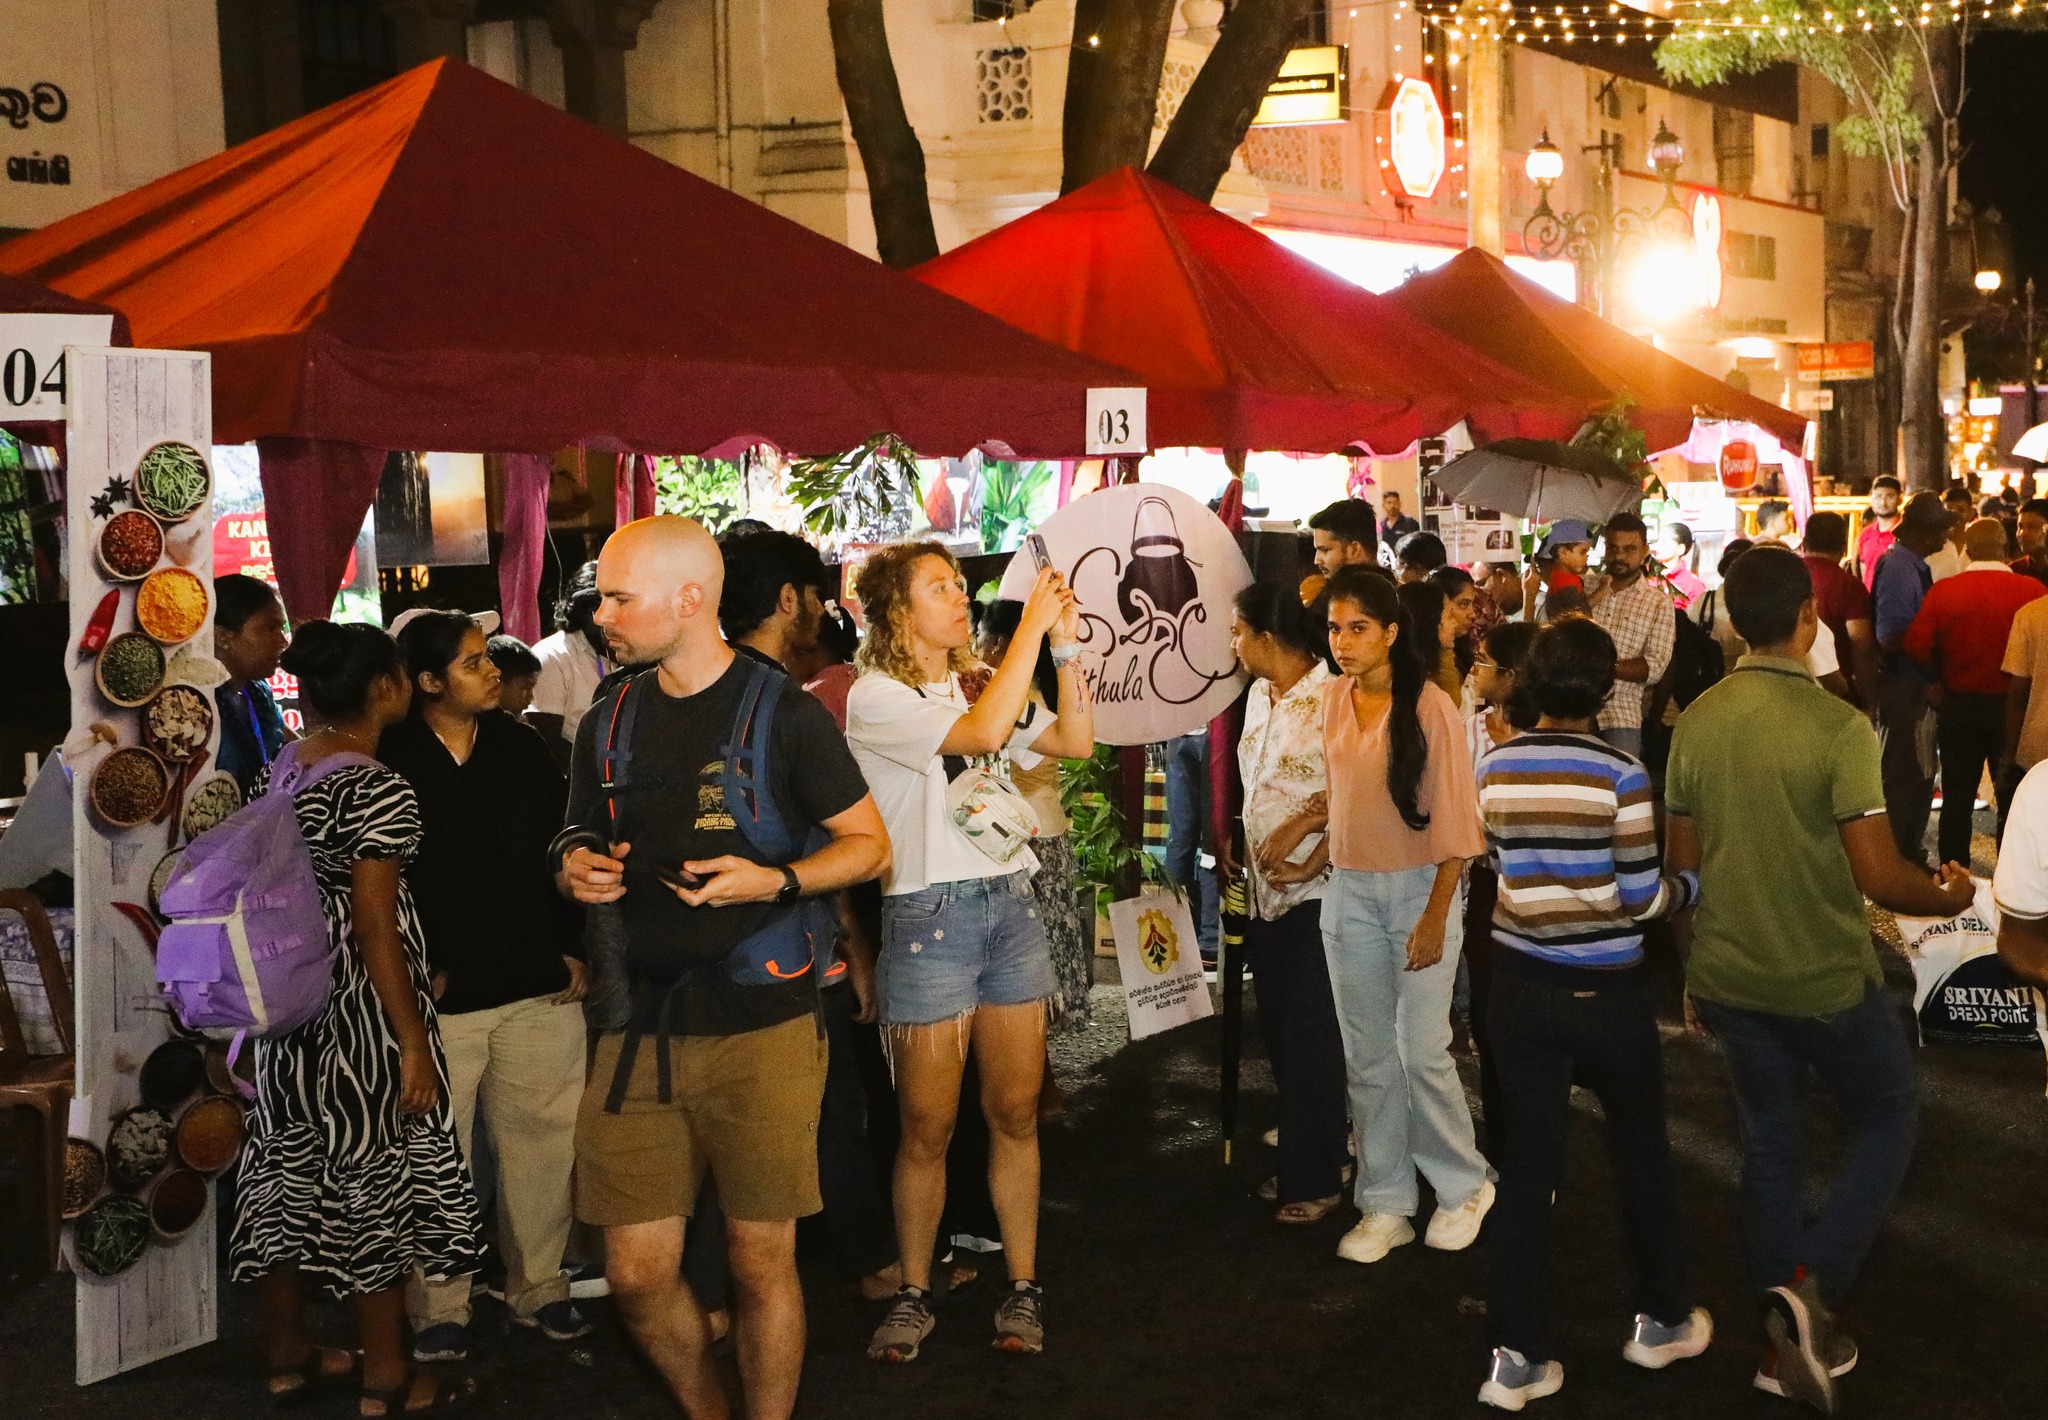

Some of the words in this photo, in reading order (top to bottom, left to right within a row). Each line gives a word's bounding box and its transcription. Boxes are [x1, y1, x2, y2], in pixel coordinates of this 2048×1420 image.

[3, 348, 67, 406] 04
[1098, 408, 1130, 445] 03
[227, 520, 268, 538] KAN
[249, 540, 272, 558] KI
[1943, 986, 2032, 1007] SRIYANI
[1948, 1005, 1988, 1022] DRESS
